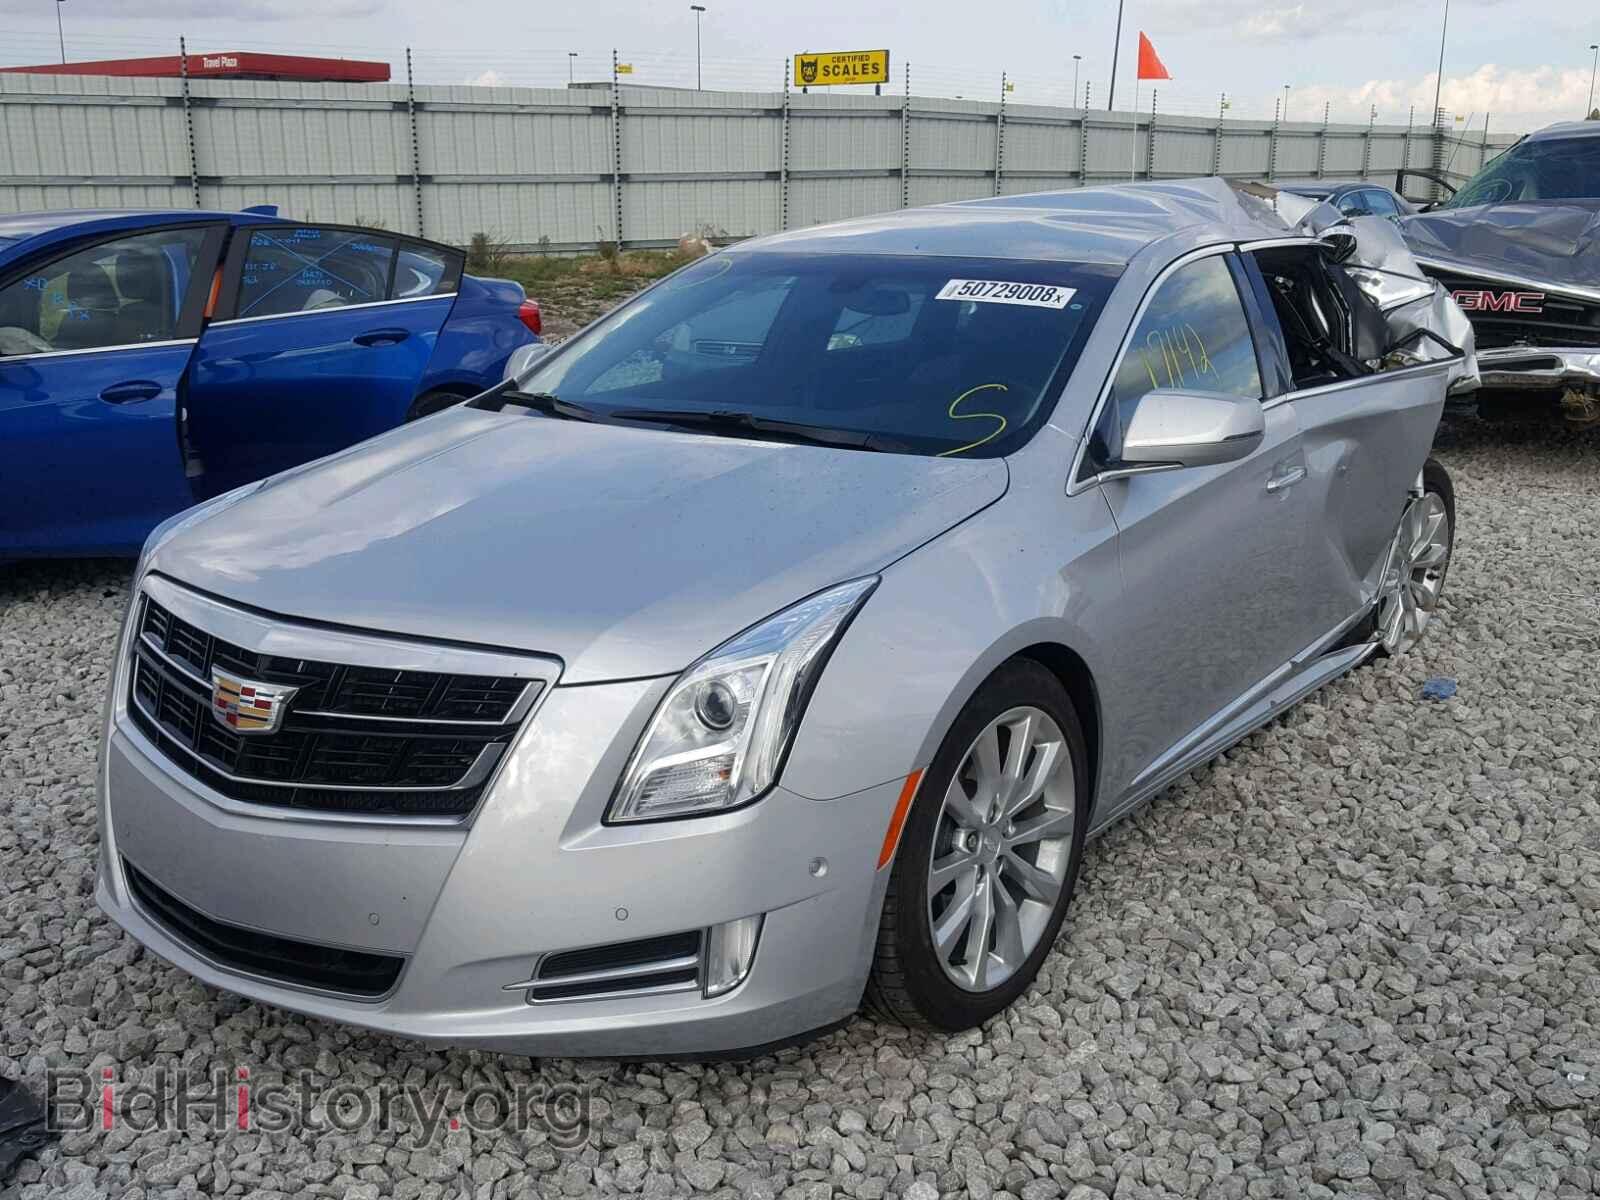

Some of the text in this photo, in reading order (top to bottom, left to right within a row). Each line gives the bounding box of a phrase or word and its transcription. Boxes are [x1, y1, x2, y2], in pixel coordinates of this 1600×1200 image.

[203, 57, 238, 68] Travel Plaza
[832, 55, 870, 64] CERTIFIED
[803, 66, 816, 76] CAT
[823, 63, 880, 77] SCALES
[1451, 290, 1545, 313] GMC
